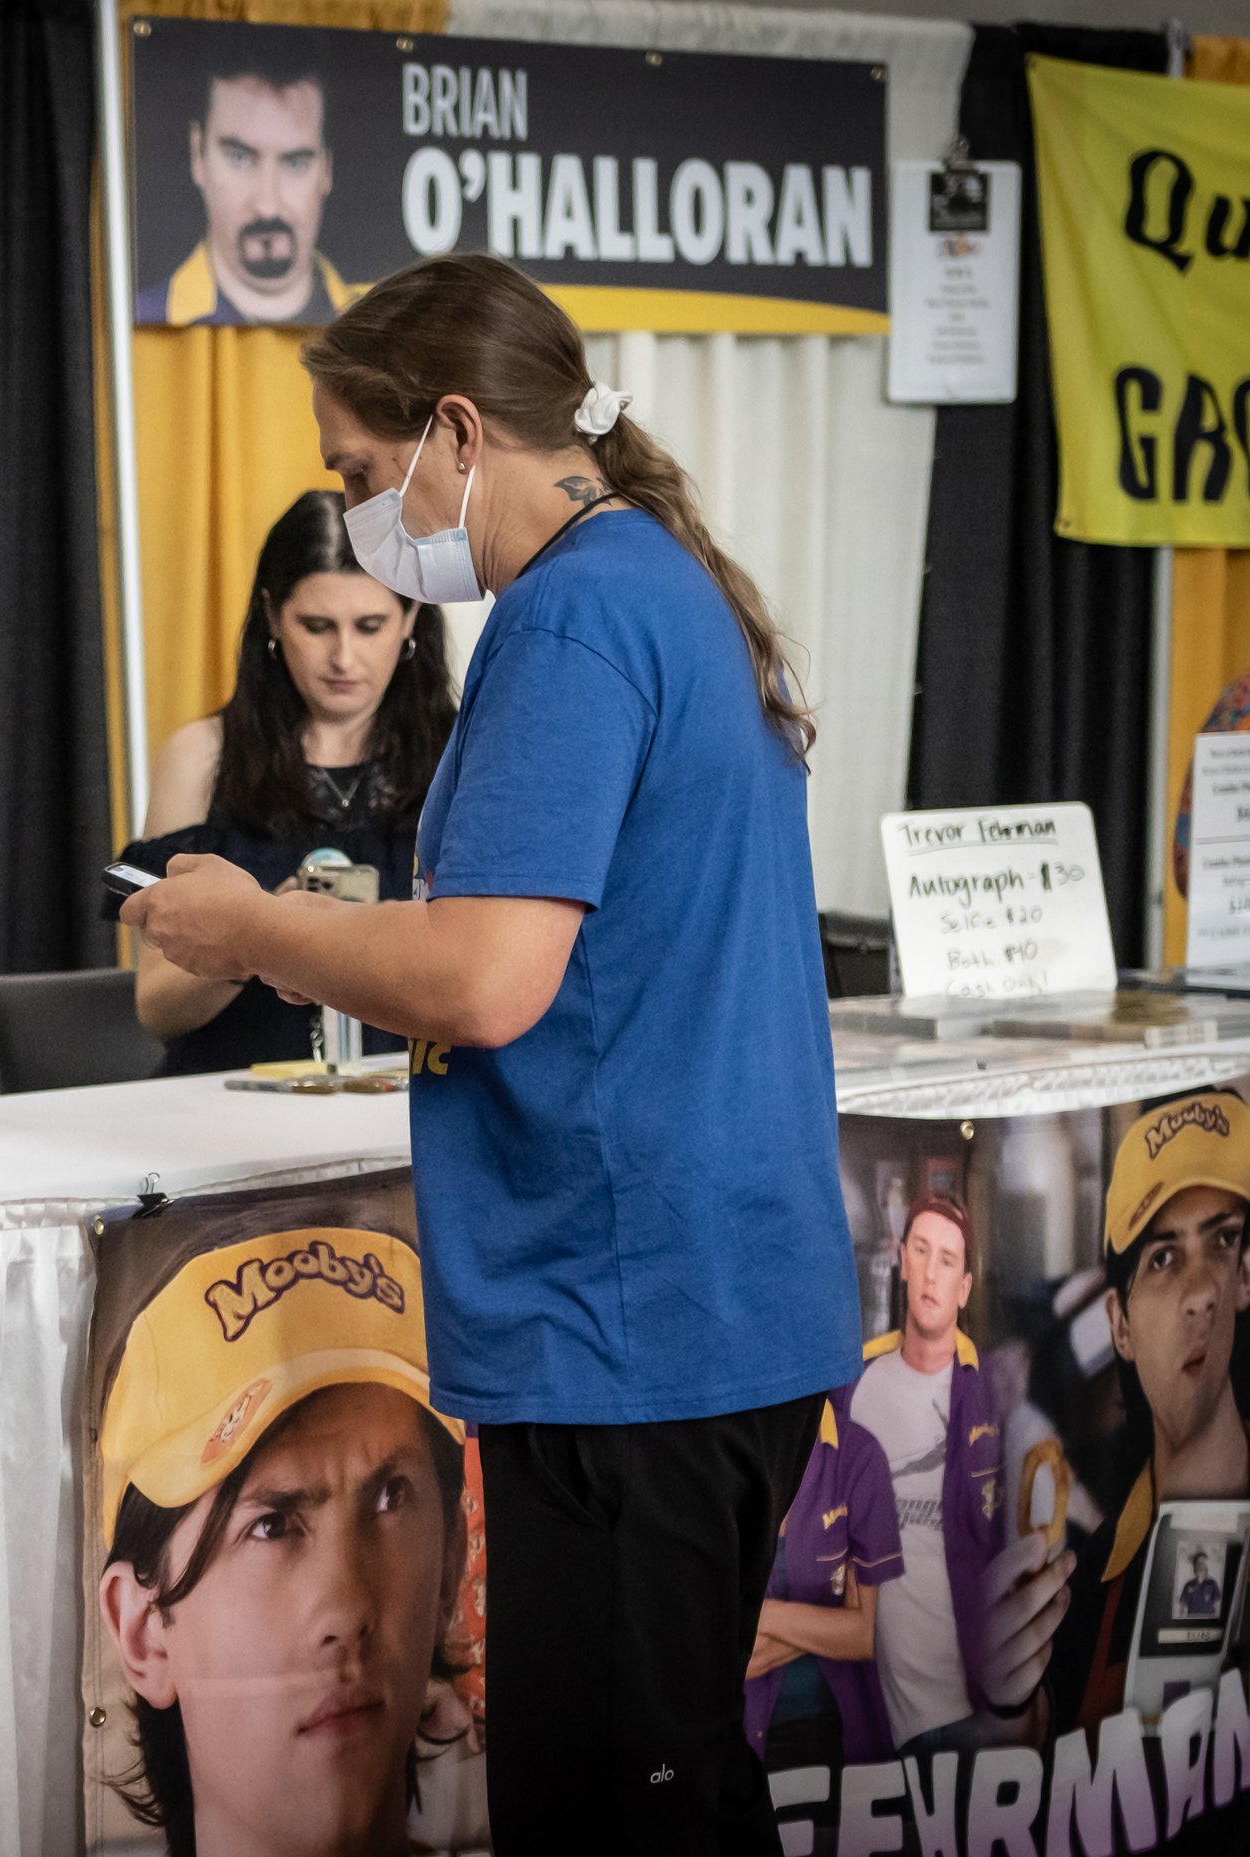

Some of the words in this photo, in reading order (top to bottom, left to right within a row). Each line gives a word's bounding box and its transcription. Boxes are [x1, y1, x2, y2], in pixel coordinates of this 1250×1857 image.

[402, 62, 528, 141] BRIAN
[899, 822, 965, 847] Trevor
[909, 866, 1025, 909] Autograph
[205, 1240, 405, 1343] Mooby's
[650, 1763, 674, 1784] alo
